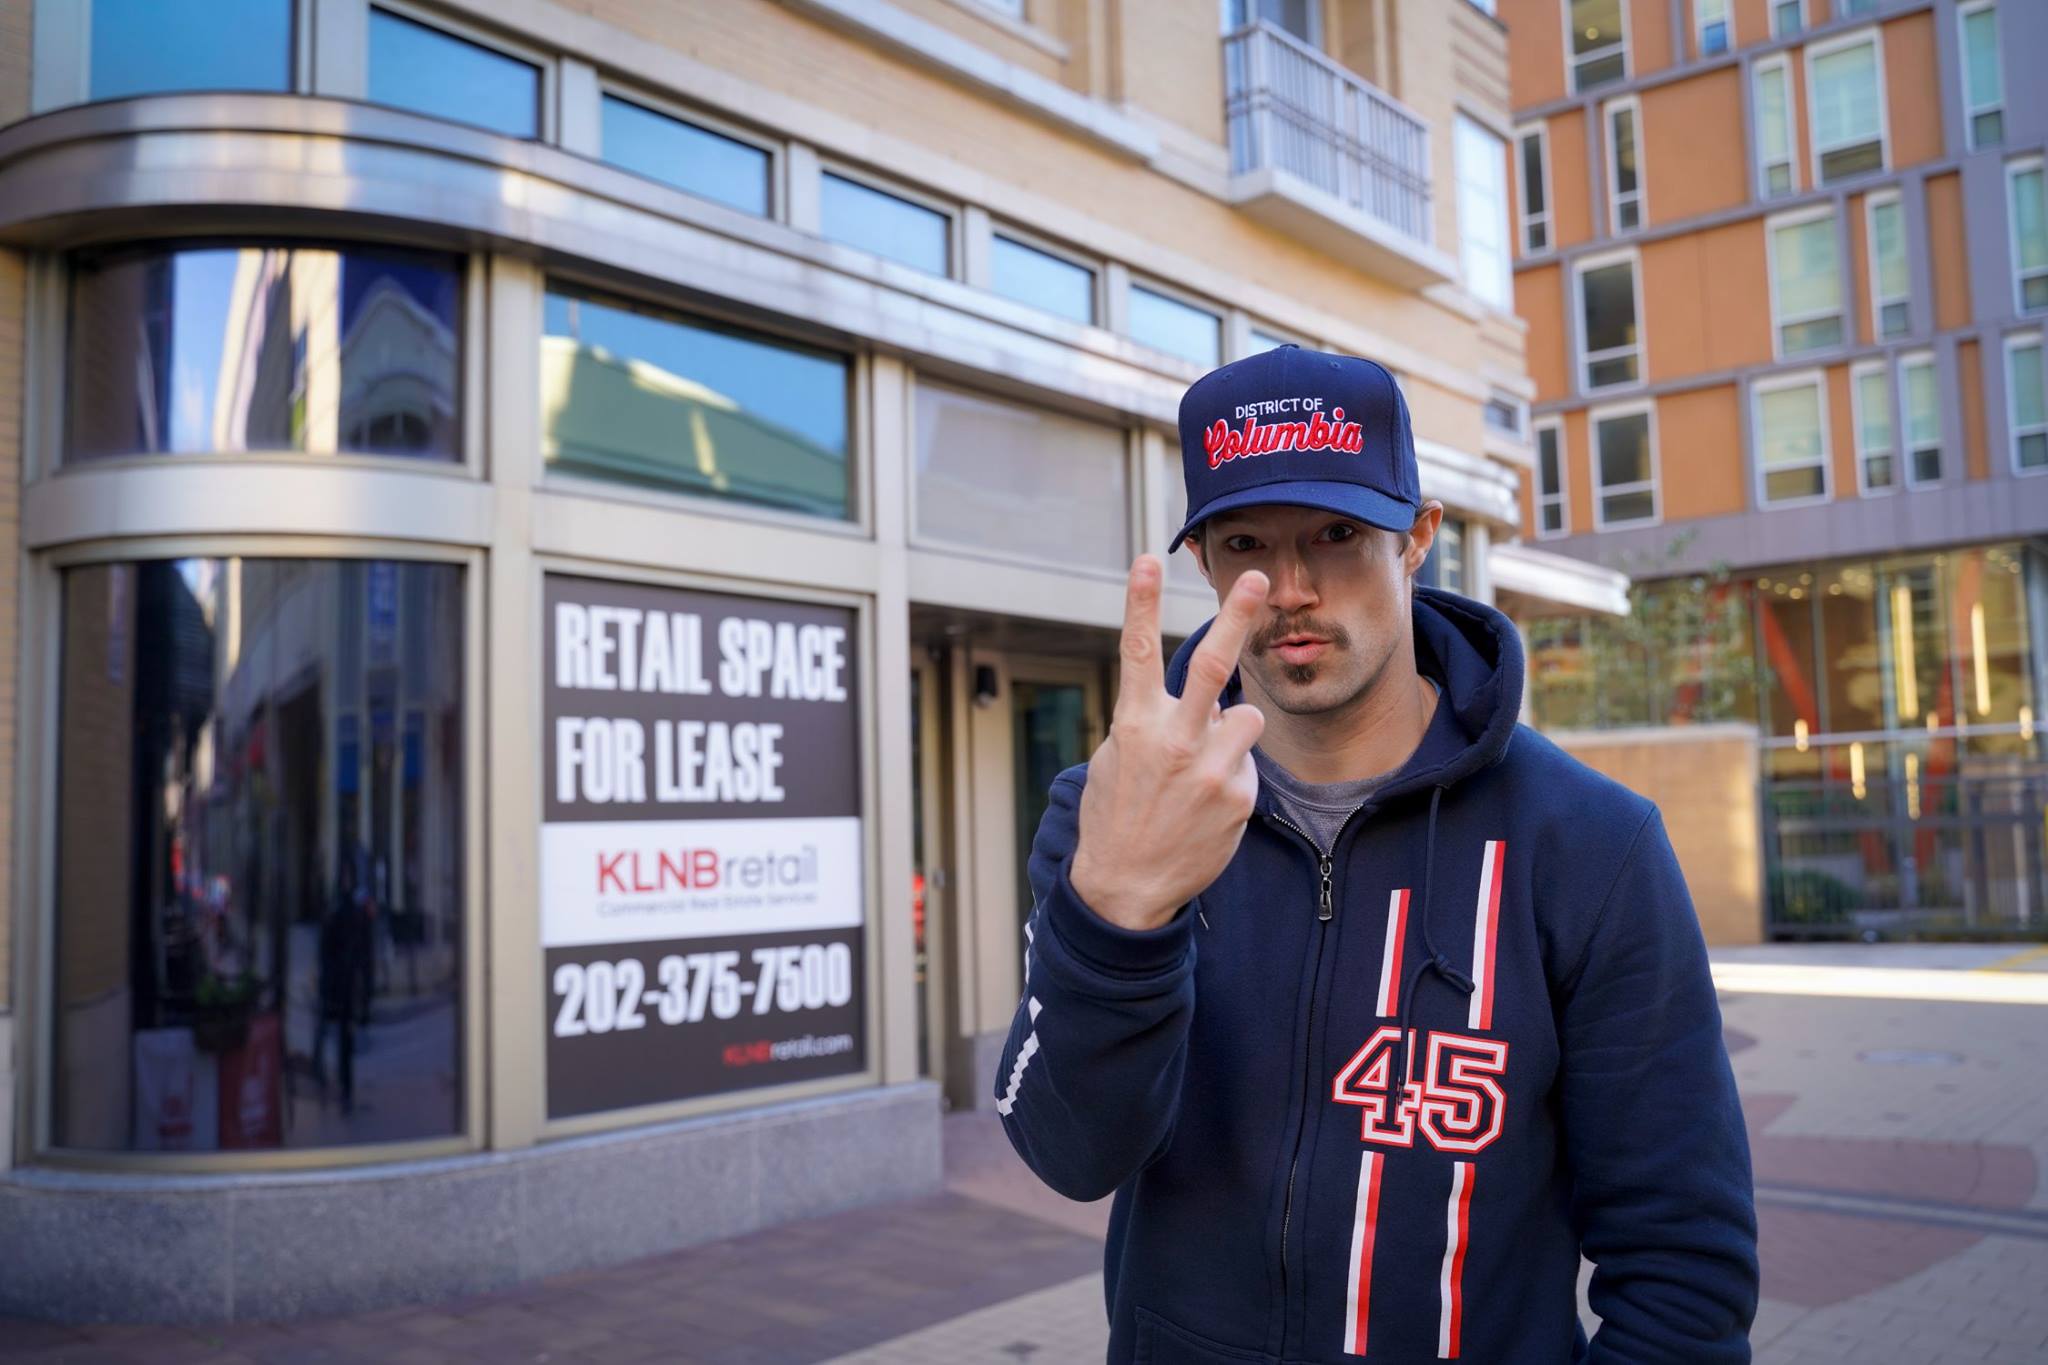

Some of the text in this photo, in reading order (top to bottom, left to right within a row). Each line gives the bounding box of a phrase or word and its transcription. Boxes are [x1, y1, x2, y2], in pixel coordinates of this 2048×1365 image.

[1203, 406, 1365, 470] Columbia
[1235, 397, 1323, 420] DISTRICT OF
[554, 602, 848, 702] RETAIL SPACE
[555, 716, 786, 803] FOR LEASE
[553, 942, 852, 1037] 202-375-7500
[1332, 1025, 1509, 1154] 45
